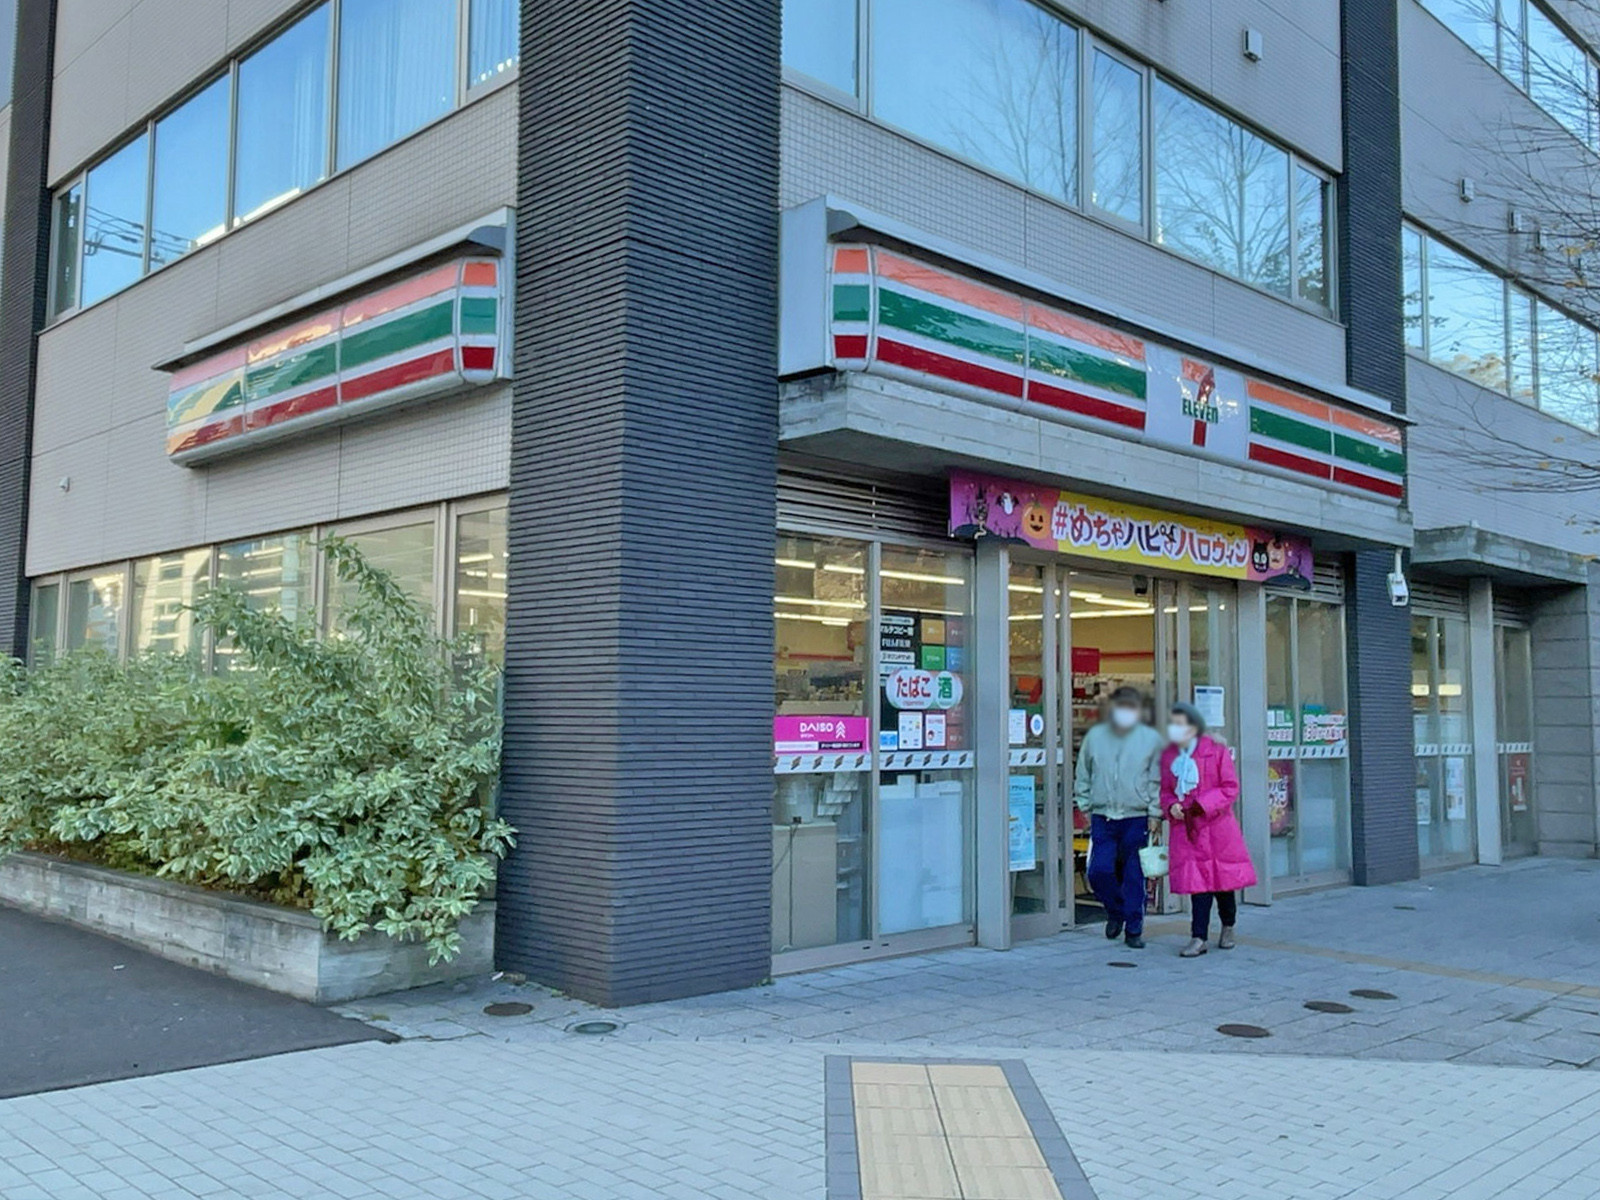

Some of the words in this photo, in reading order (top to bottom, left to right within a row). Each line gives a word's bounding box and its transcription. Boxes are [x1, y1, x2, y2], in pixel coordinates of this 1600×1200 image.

[896, 675, 931, 698] たばこ
[938, 676, 953, 698] 酒
[799, 722, 834, 733] DAISO
